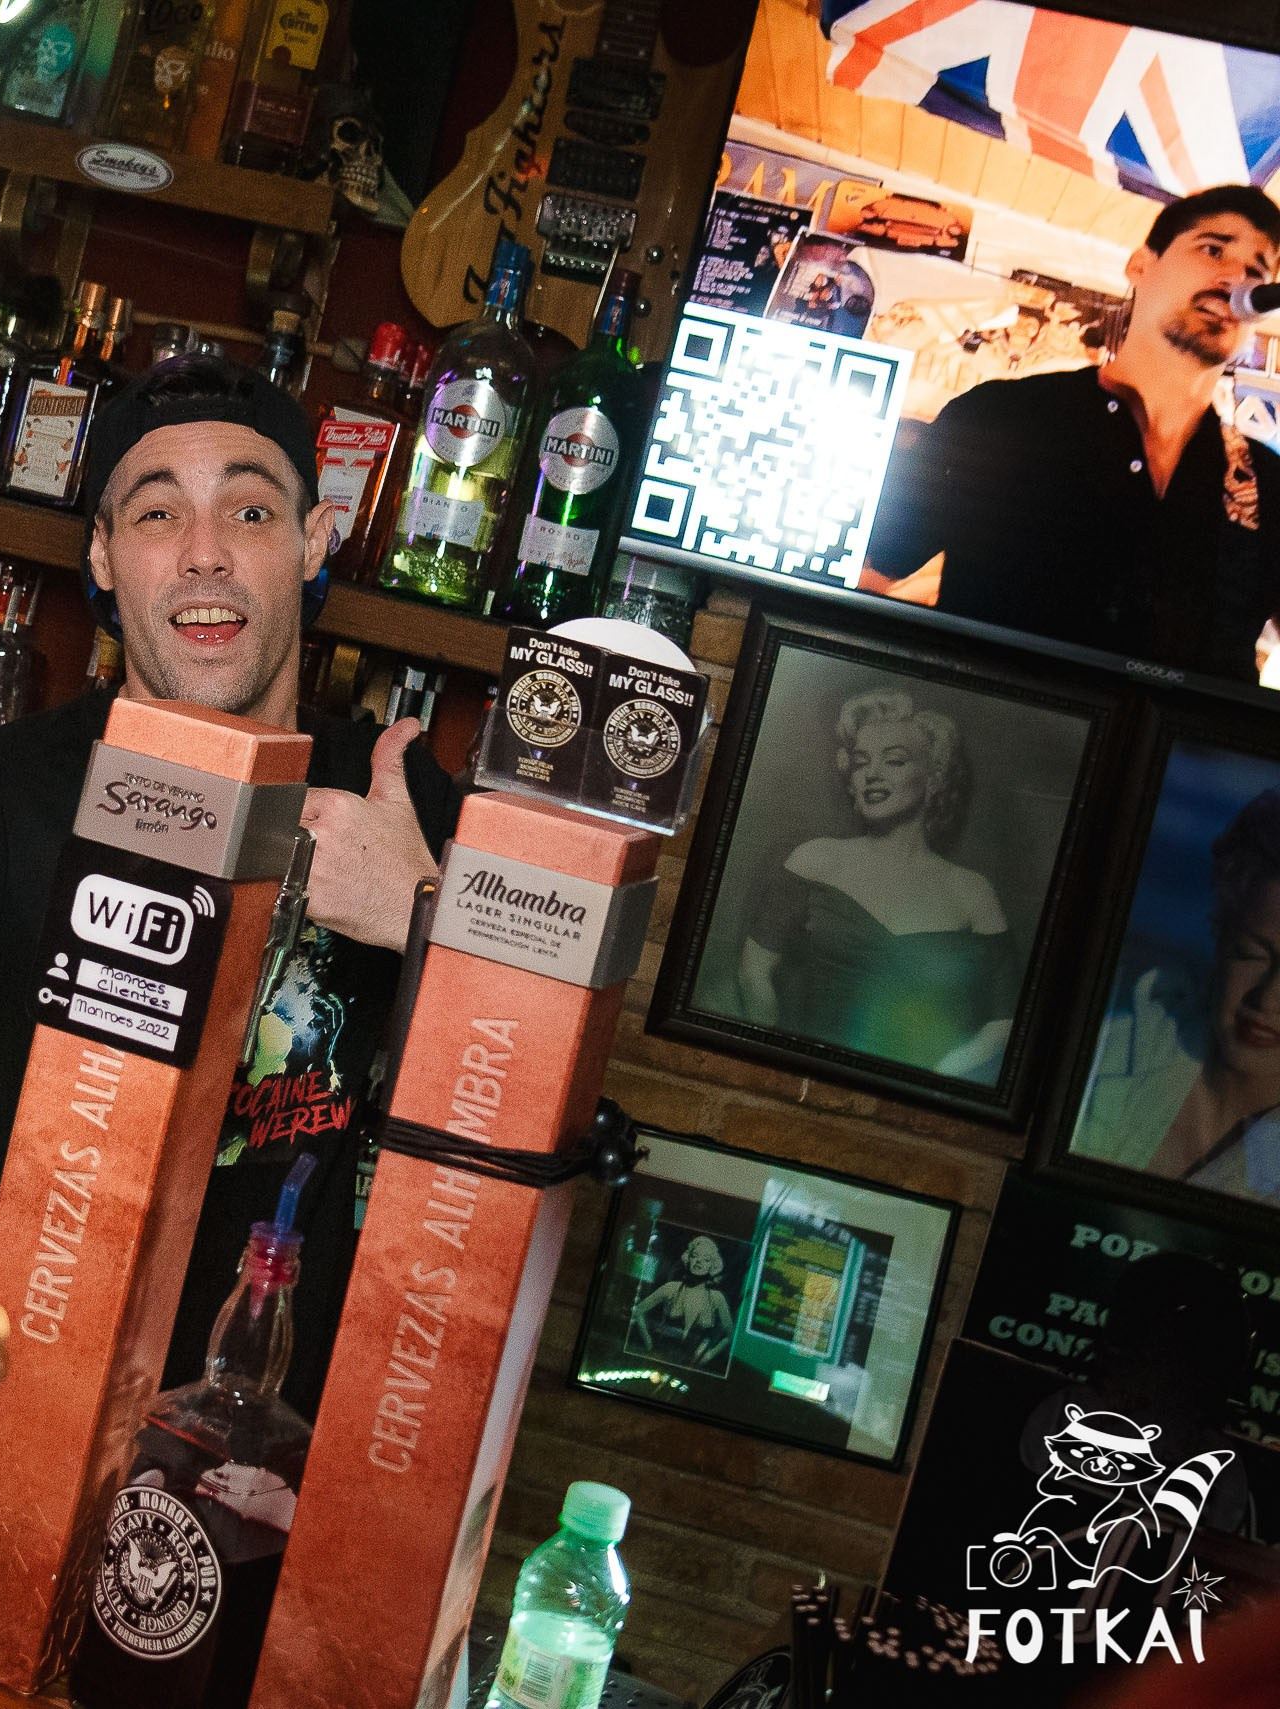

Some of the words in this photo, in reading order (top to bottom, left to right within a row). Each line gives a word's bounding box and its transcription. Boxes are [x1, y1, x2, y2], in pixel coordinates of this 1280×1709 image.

[432, 408, 500, 437] MARTINI
[546, 437, 614, 466] MARTINI
[422, 496, 470, 514] BIANO
[509, 646, 534, 662] MY
[535, 651, 594, 679] GLASS!!
[529, 637, 559, 655] Don't
[558, 644, 581, 660] take
[608, 673, 634, 691] MY
[634, 679, 695, 708] GLASS!!
[627, 665, 658, 682] Don't
[658, 672, 681, 688] take
[96, 780, 218, 831] Sarango
[458, 869, 588, 927] Alhambra
[88, 890, 180, 950] WiFi
[509, 912, 582, 942] SINGULAR
[96, 978, 171, 1011] Clientes
[135, 1018, 171, 1040] 2022
[19, 1139, 102, 1345] CERVEZAS
[366, 1264, 457, 1474] CERVEZAS
[421, 1016, 521, 1251] ALHMBRA
[108, 1514, 156, 1548] HEAVY
[165, 1529, 198, 1586] ROCK
[197, 1555, 216, 1588] PUB
[104, 1561, 129, 1618] PUNK
[138, 1599, 190, 1631] GRUNGE
[111, 1619, 163, 1651] TORREVIEJA
